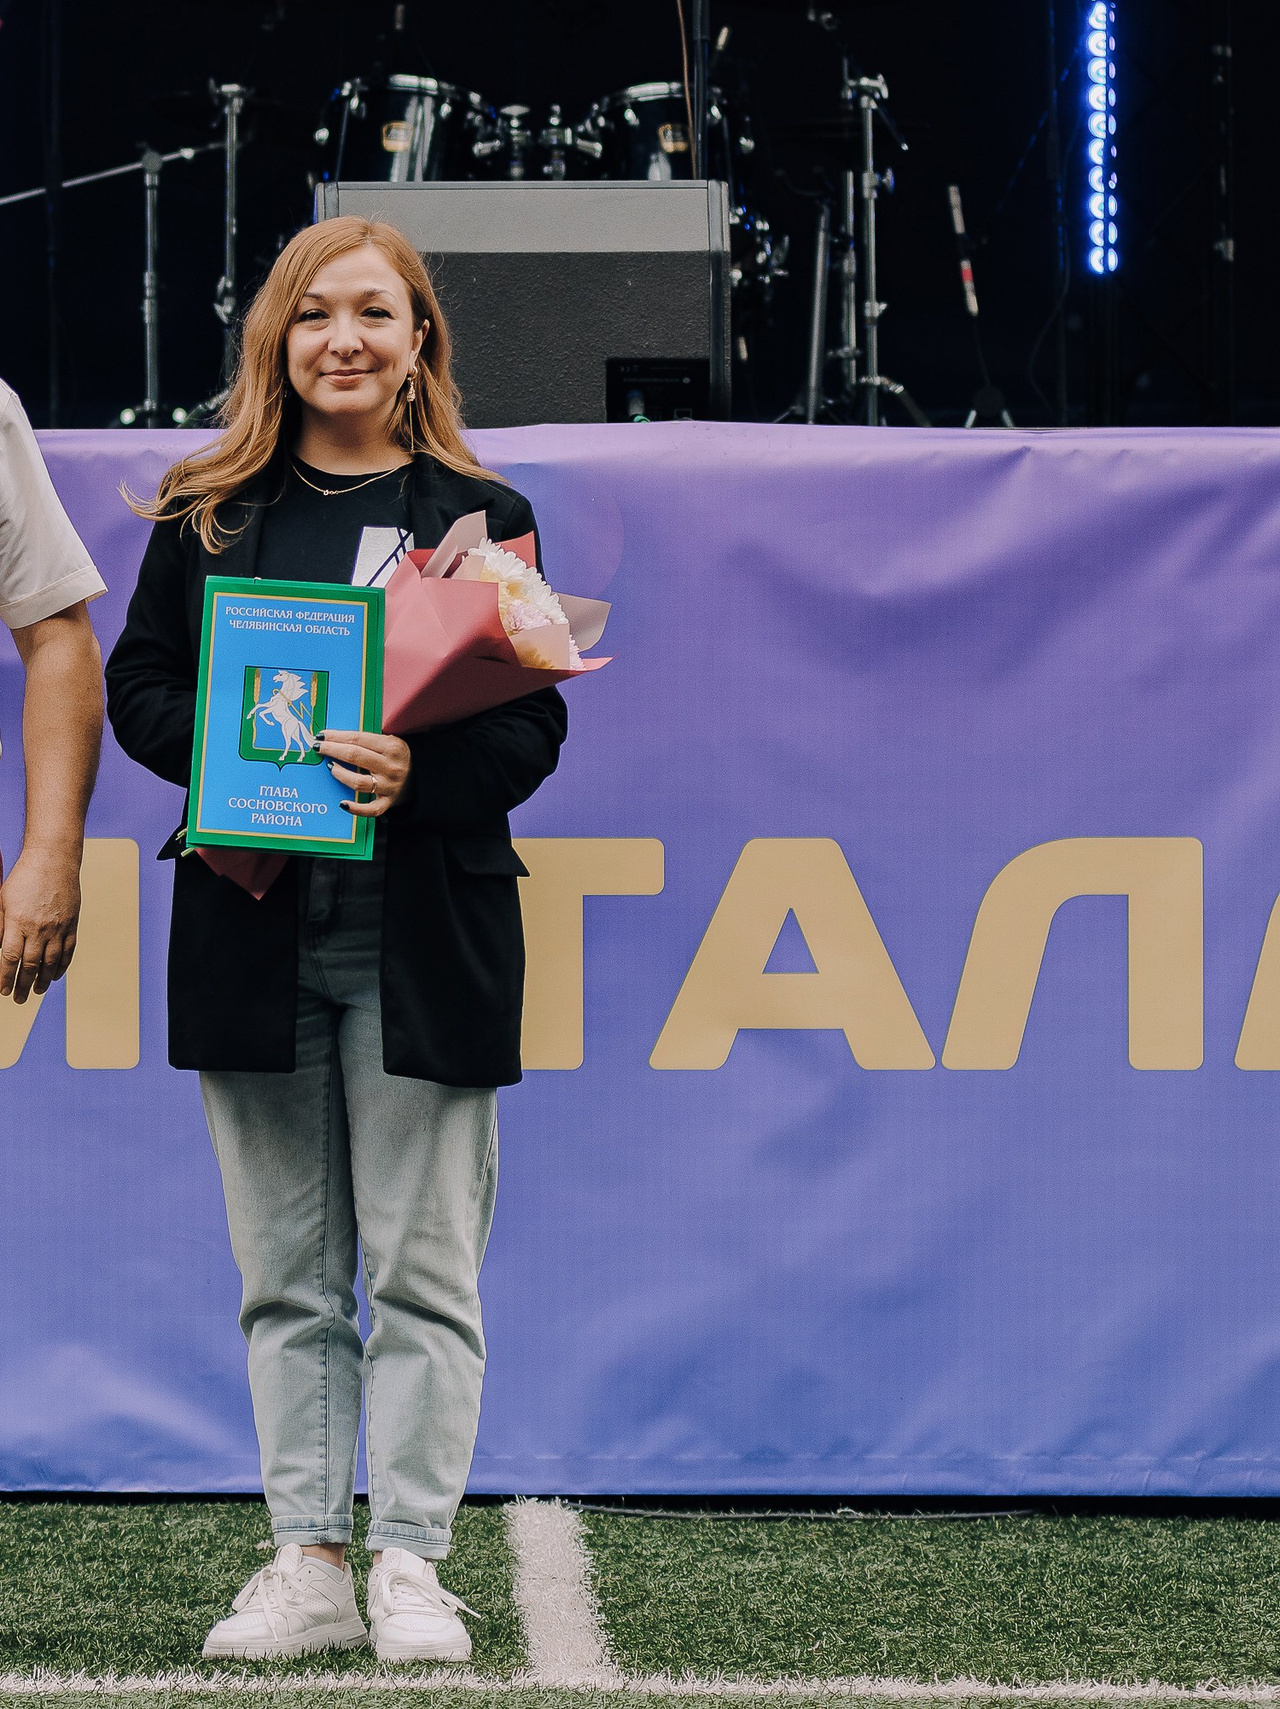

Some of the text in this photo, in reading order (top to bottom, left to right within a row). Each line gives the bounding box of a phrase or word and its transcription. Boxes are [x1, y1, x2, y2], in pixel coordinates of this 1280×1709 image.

[225, 605, 355, 623] РОССИЙСКАЯ ФЕДЕРАЦИЯ
[229, 619, 351, 636] ЧЕЛЯБИНСКАЯ ОБЛАСТЬ
[259, 785, 299, 798] ГЛАВА
[228, 797, 328, 815] СОСНОВСКОГО
[250, 812, 302, 827] РАЙОНА
